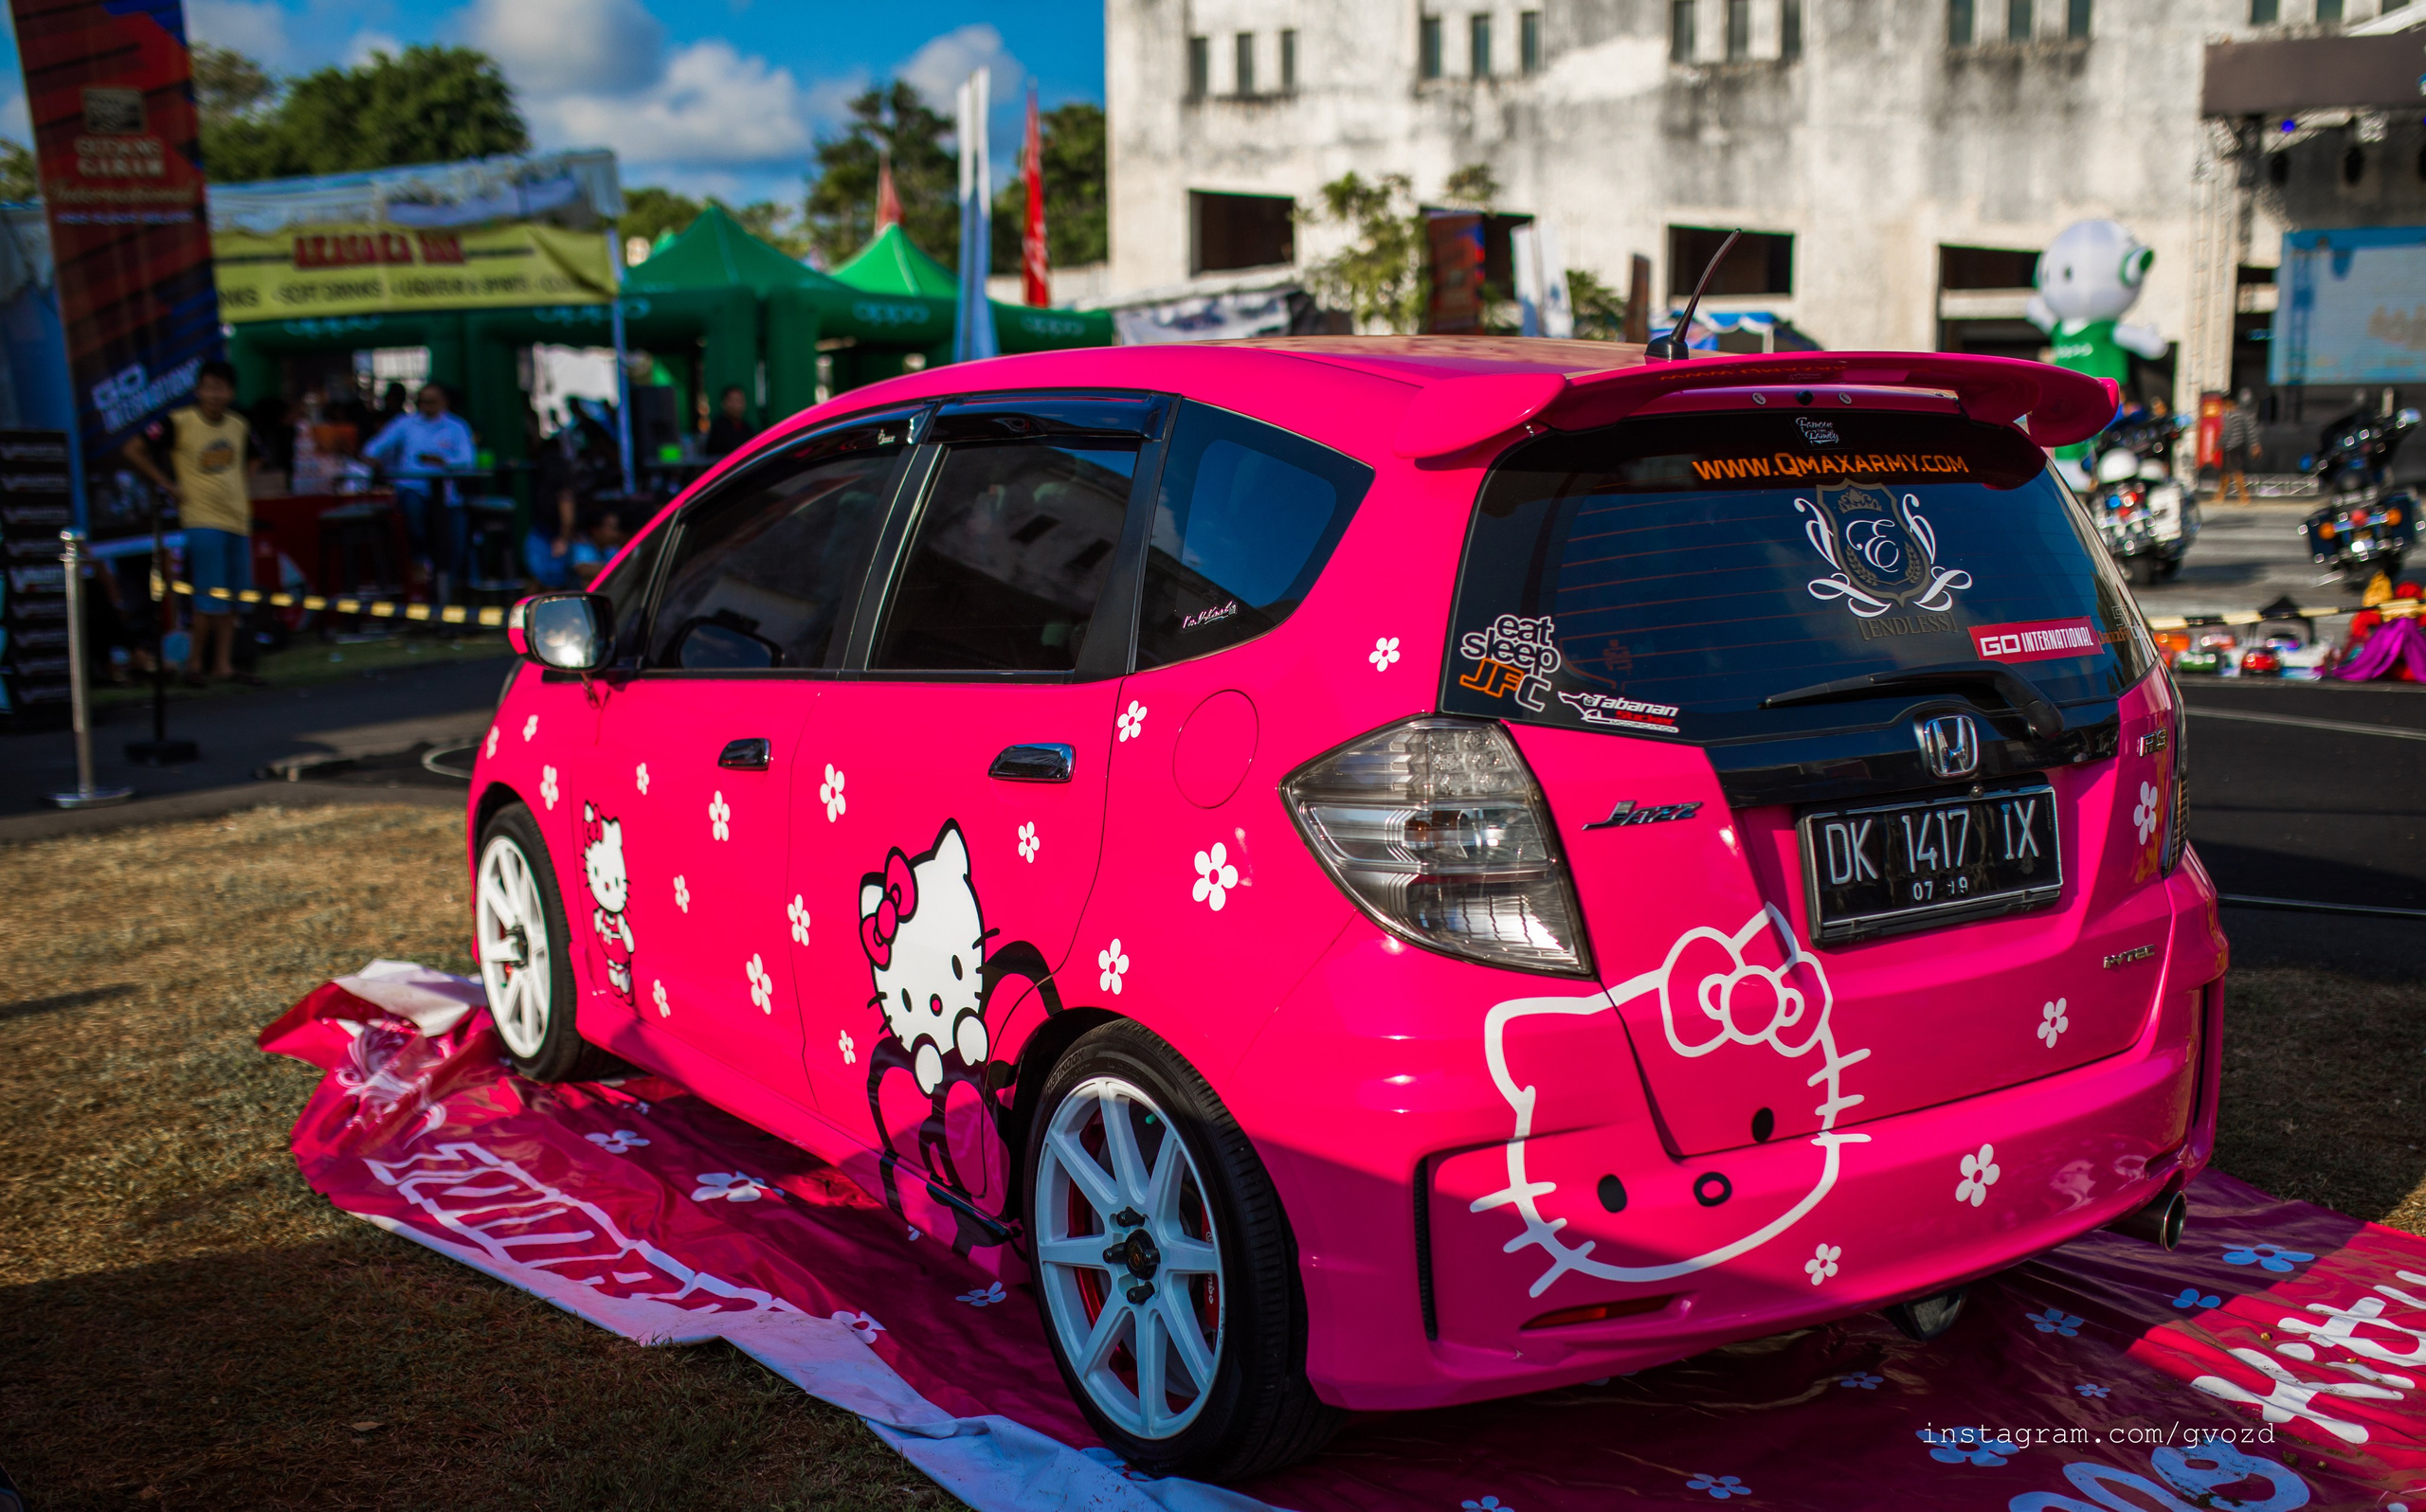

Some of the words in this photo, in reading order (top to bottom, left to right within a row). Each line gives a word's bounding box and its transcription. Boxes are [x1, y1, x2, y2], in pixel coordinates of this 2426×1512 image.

[1494, 614, 1555, 646] eat
[1980, 634, 2021, 657] GO
[2020, 626, 2094, 653] INTERNATIONAL
[1459, 627, 1562, 677] sleep
[1593, 693, 1680, 717] Tabanan
[1824, 818, 1879, 886] DK
[1901, 807, 1971, 873] 1417
[2001, 799, 2040, 860] IX
[1912, 880, 1934, 902] 07
